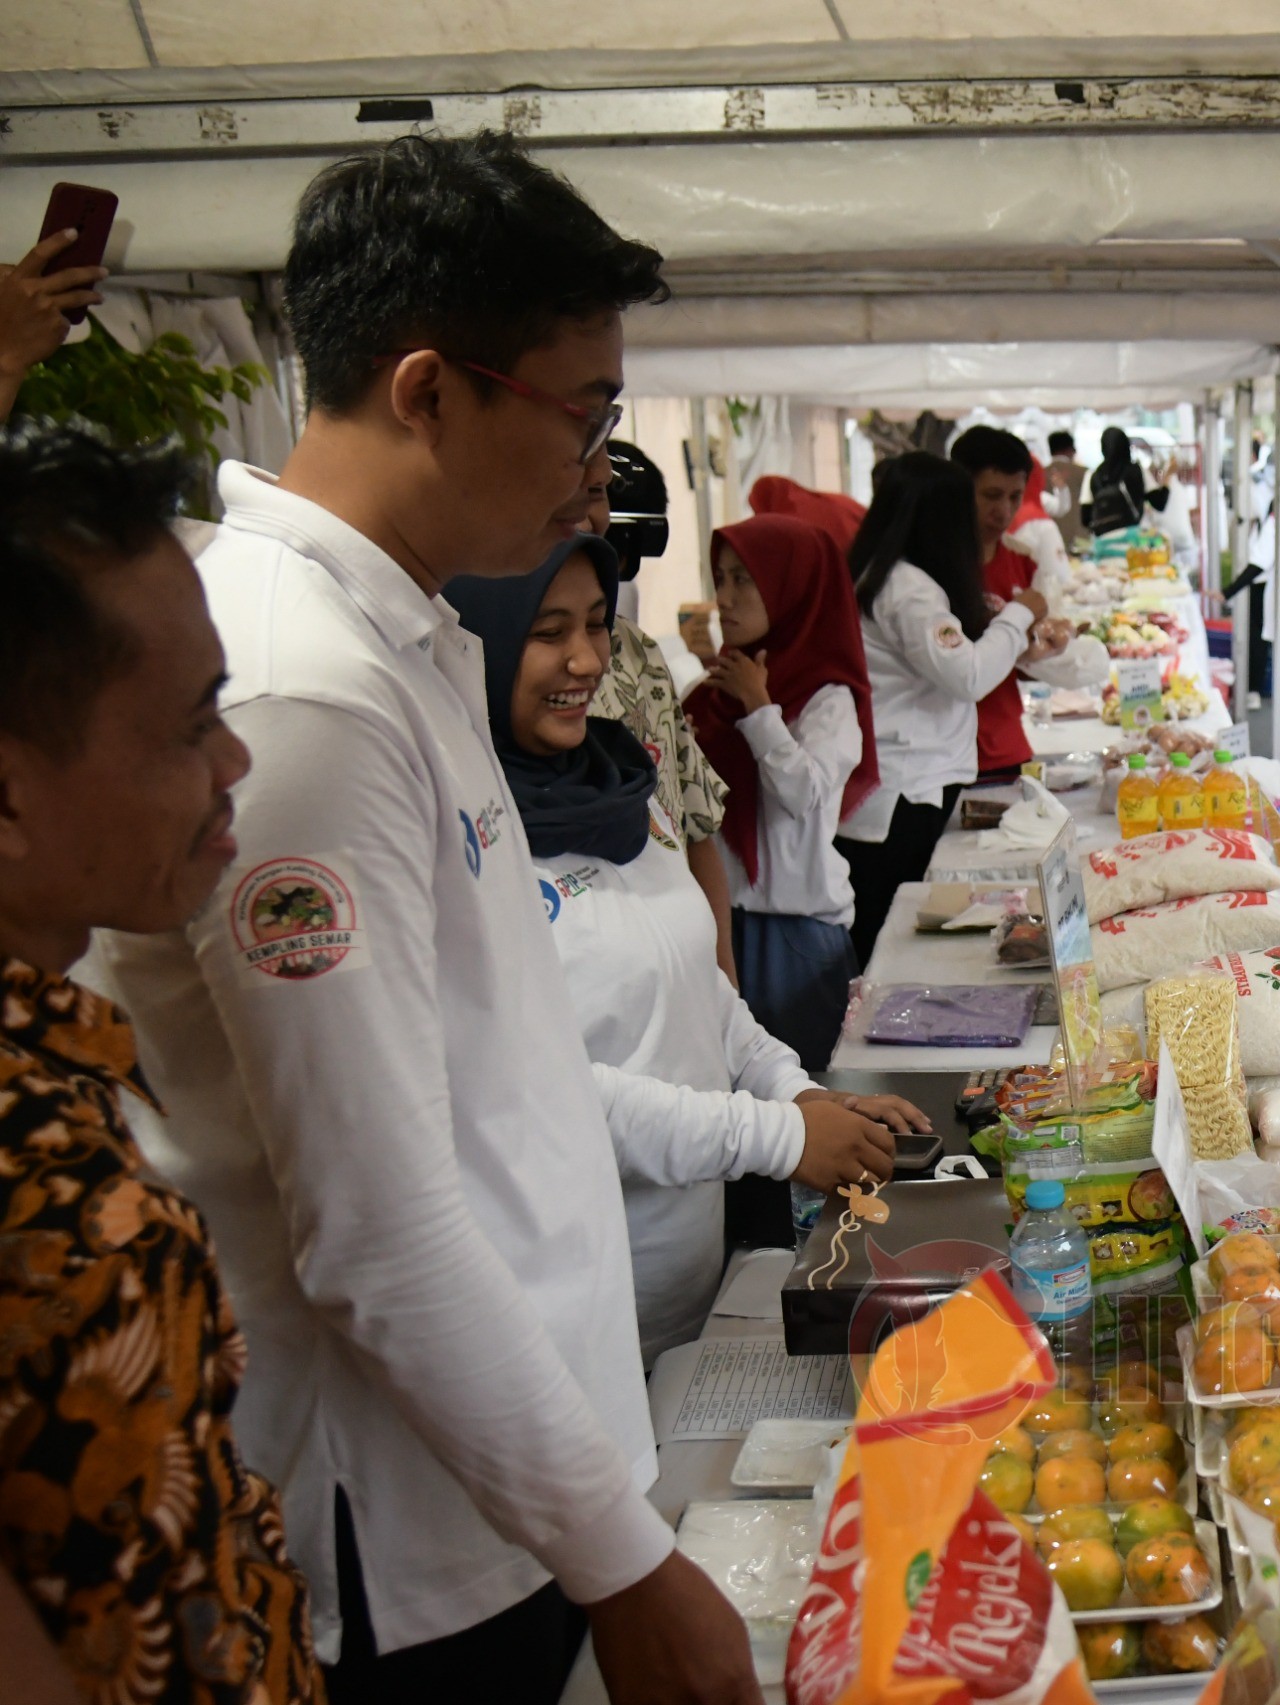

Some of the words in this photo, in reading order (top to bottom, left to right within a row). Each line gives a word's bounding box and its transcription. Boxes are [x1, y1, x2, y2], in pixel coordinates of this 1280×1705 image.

[310, 932, 351, 948] SEMAR
[1053, 1291, 1067, 1299] Air
[948, 1519, 1033, 1675] Rejeki
